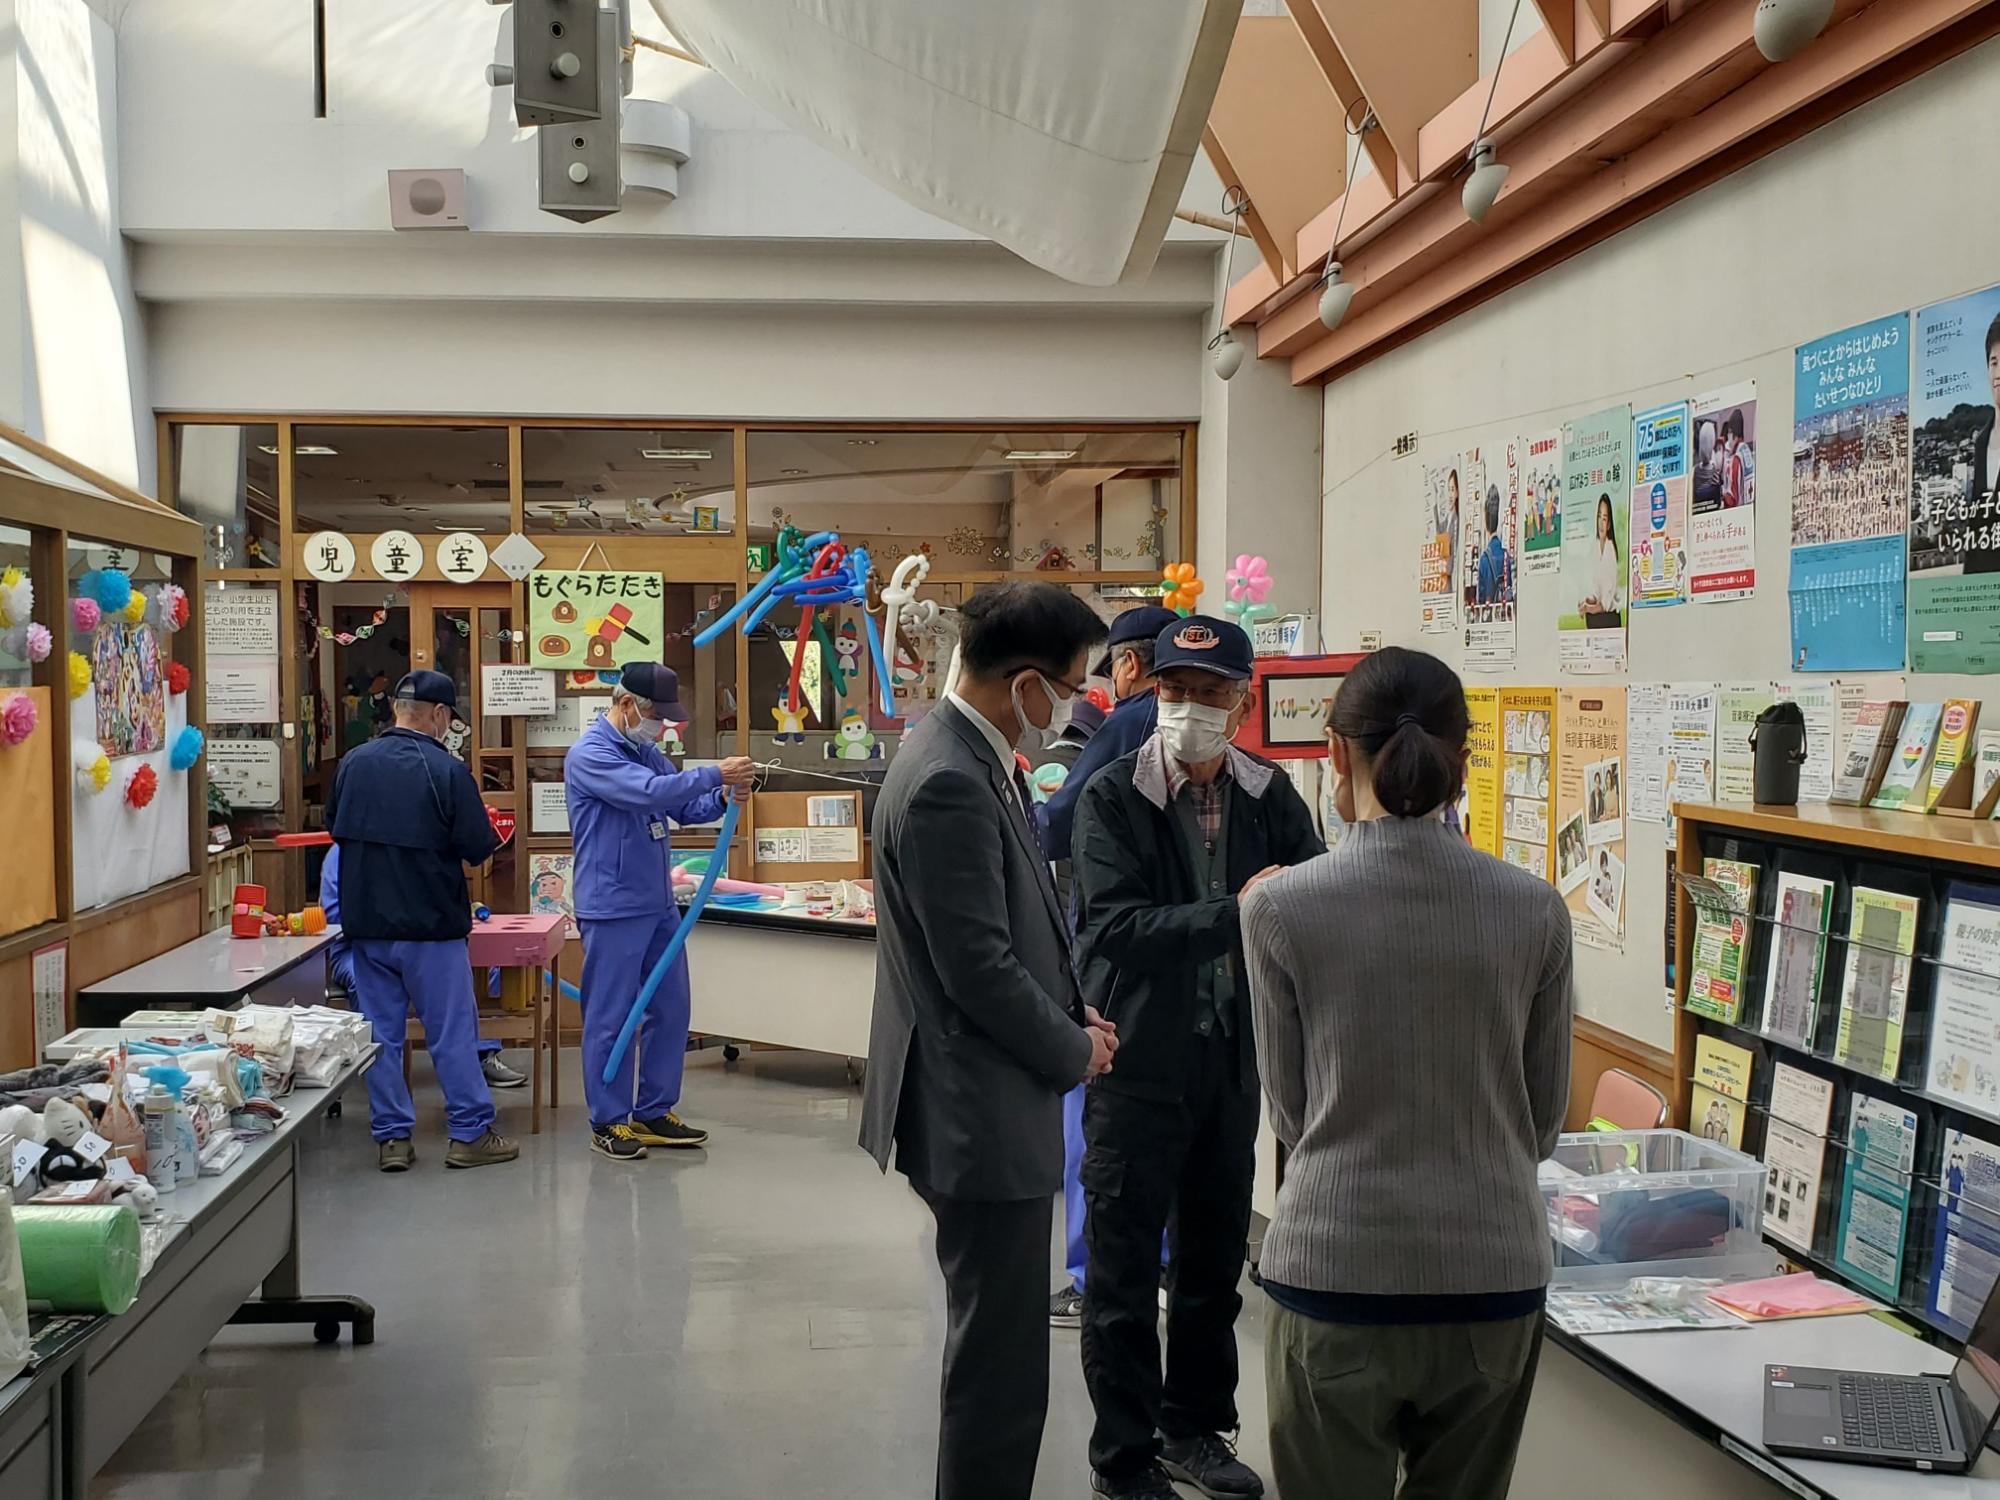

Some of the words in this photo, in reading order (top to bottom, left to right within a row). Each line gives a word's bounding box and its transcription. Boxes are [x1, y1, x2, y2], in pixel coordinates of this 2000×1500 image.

[1802, 326, 1900, 372] 気づくことからはじめよう
[1819, 366, 1845, 386] みんな
[1847, 356, 1876, 376] みんな
[1814, 375, 1882, 409] たいせつなひとり
[326, 536, 335, 547] じ
[387, 536, 407, 546] どう
[316, 546, 344, 573] 児
[384, 545, 411, 574] 童
[447, 545, 475, 573] 室
[533, 574, 661, 599] もぐらたたき
